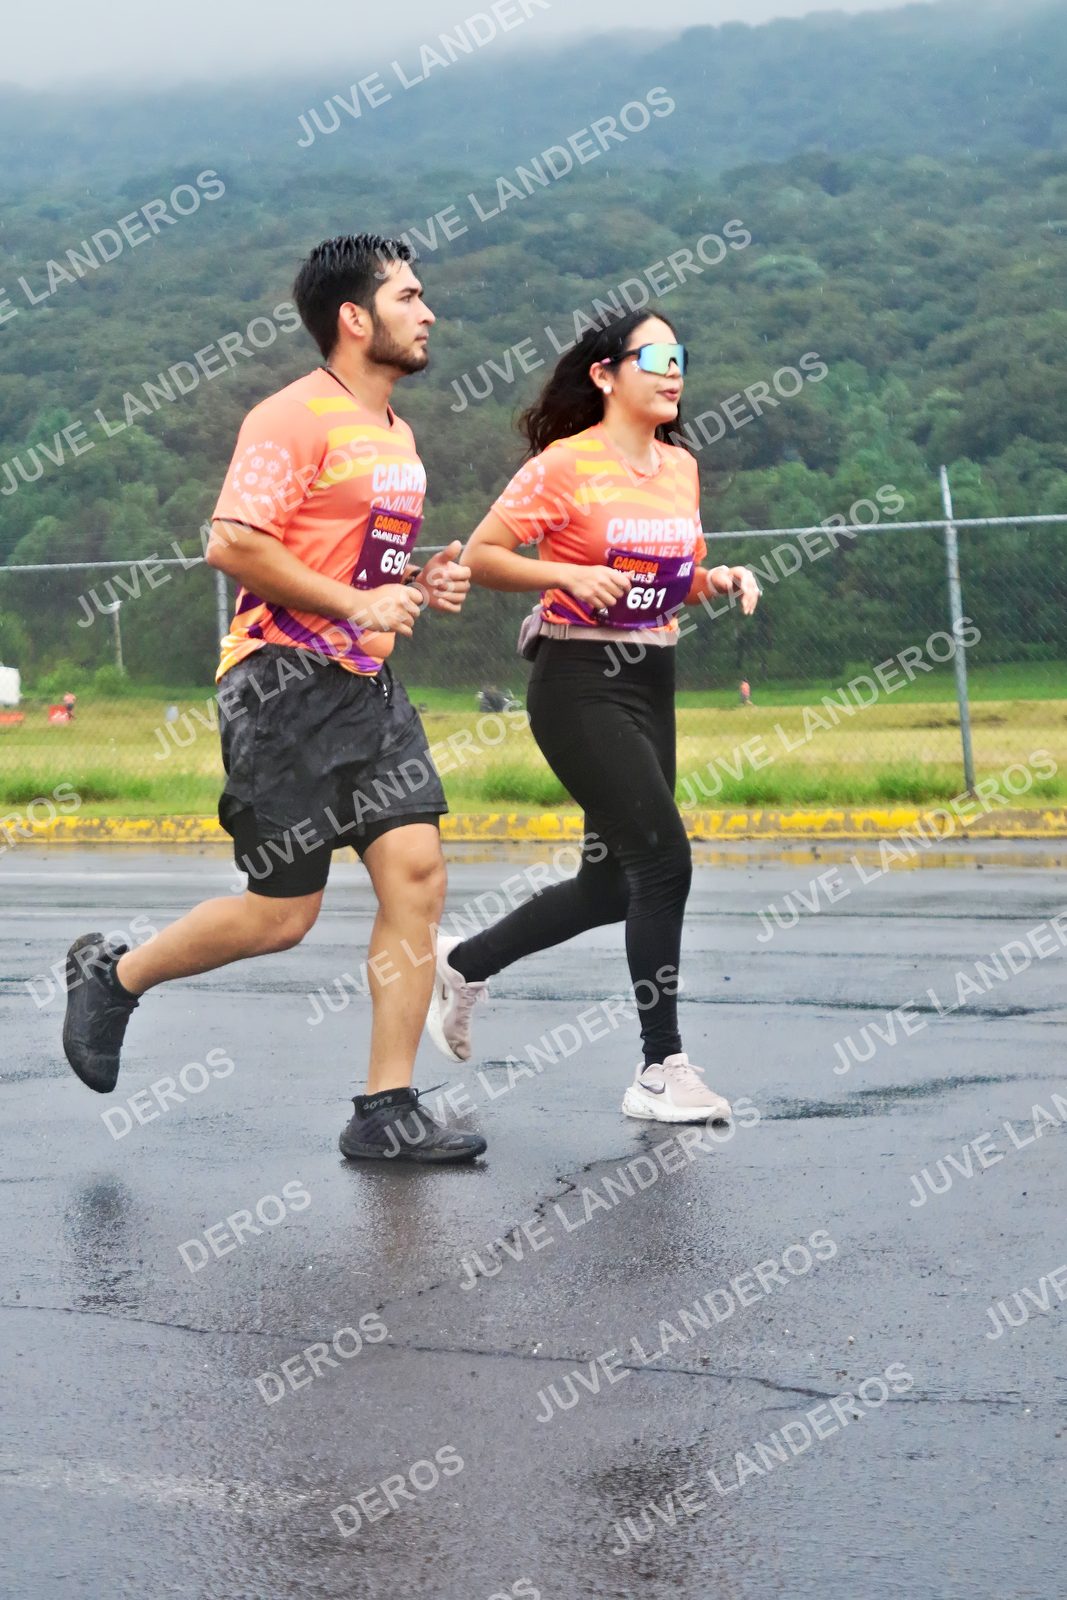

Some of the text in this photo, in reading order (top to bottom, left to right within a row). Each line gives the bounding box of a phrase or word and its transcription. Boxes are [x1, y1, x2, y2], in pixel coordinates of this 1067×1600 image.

[374, 515, 412, 534] CARRERA
[606, 518, 697, 544] CARRERA
[613, 556, 659, 574] CARRERA
[626, 586, 667, 610] 691
